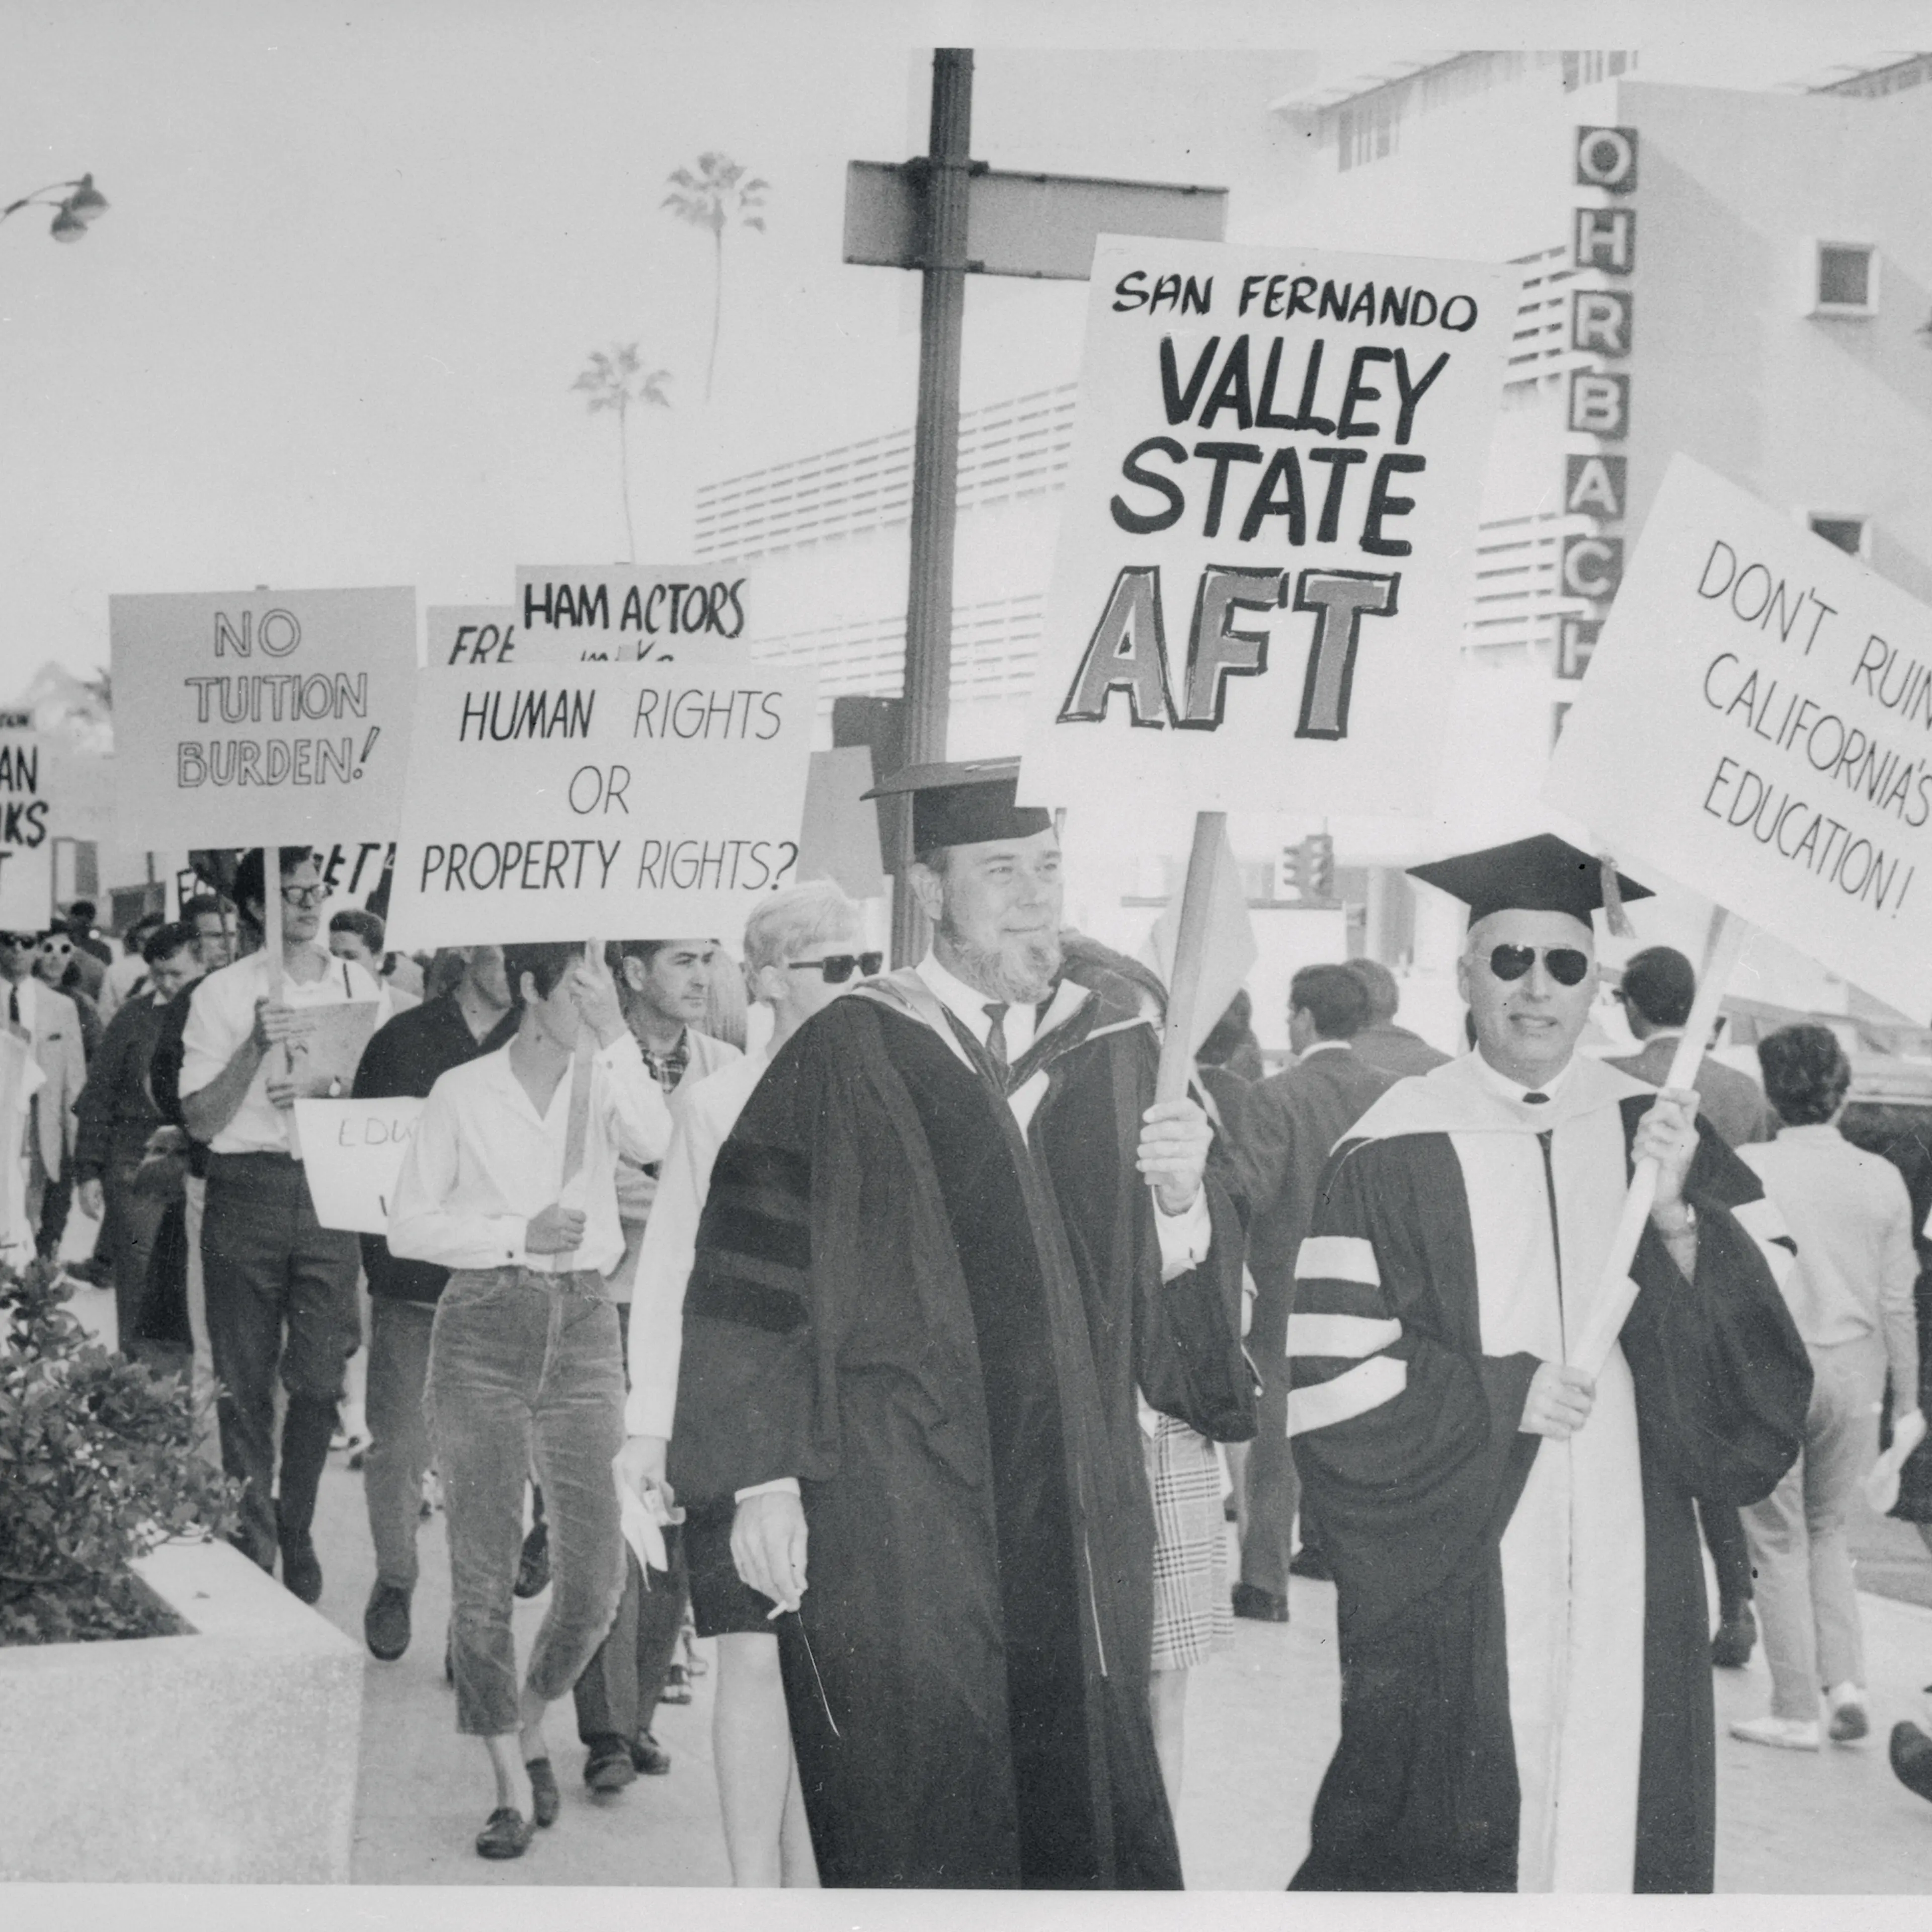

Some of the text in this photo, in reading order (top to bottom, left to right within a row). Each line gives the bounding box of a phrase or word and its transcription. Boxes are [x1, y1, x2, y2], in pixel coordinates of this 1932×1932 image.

[1112, 270, 1478, 332] SAN FERNANDO
[1160, 334, 1450, 444] VALLEY
[1110, 436, 1426, 556] STATE
[524, 579, 747, 638] HAM ACTORS
[1697, 540, 1837, 656] DON'T
[215, 609, 301, 657] NO
[1056, 564, 1401, 740] AFT
[186, 673, 367, 722] TUITION
[460, 689, 782, 741] HUMAN RIGHTS
[178, 727, 380, 787] BURDEN!
[1704, 653, 1932, 827] CALIFORNIA'S
[569, 766, 630, 814] OR
[421, 840, 798, 892] PROPERTY RIGHTS?
[1703, 756, 1914, 919] EDUCATION!
